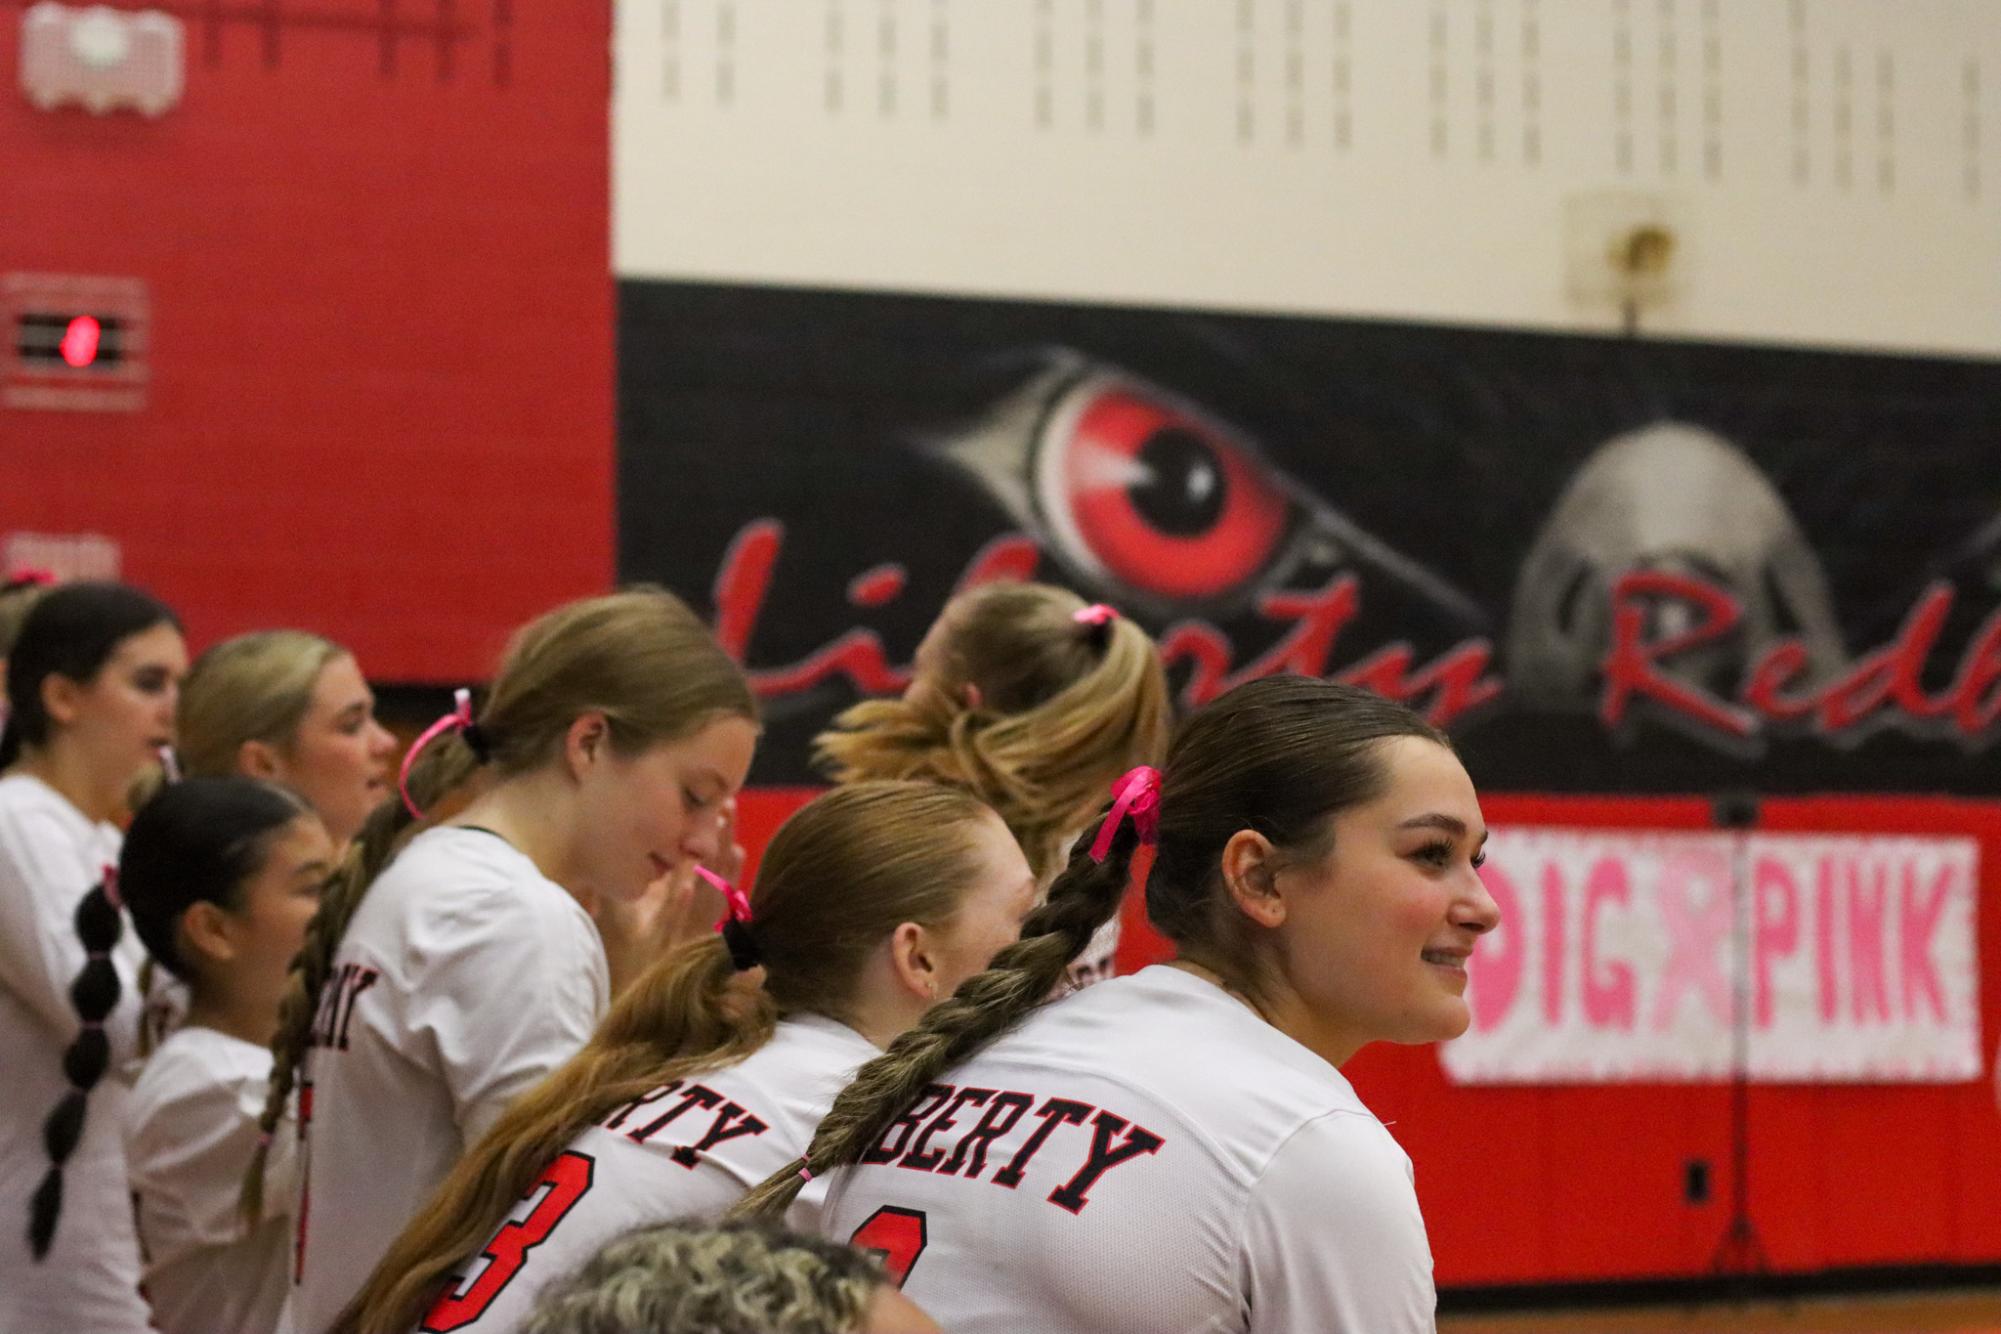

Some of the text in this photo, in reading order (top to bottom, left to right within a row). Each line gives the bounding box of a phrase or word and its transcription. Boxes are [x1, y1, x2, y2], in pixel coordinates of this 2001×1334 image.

[714, 520, 1501, 728] Lirty
[1470, 856, 1955, 1035] DIG PINK
[419, 1149, 596, 1333] 3
